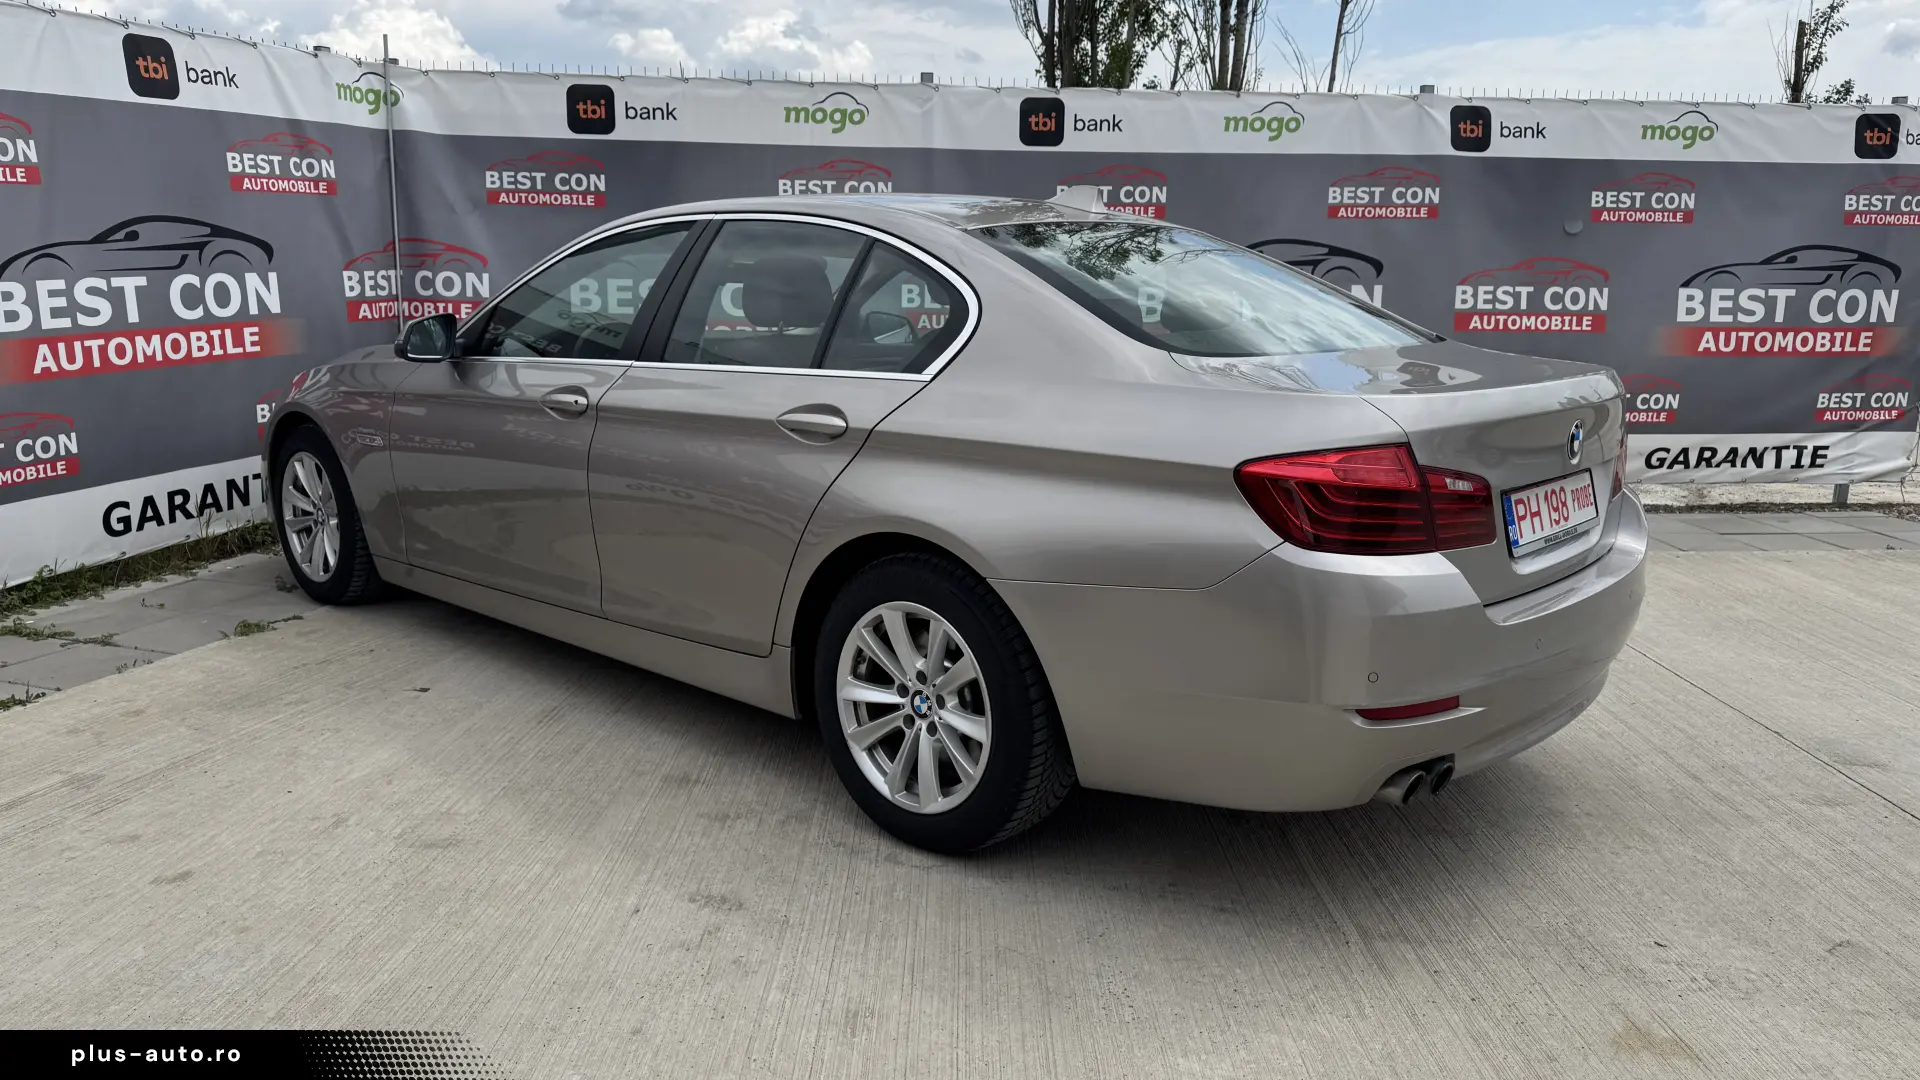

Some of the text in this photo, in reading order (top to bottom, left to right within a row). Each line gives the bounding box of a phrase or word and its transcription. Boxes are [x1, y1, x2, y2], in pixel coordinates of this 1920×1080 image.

[136, 55, 240, 89] tbi bank
[335, 82, 401, 115] mogo
[576, 100, 678, 121] tbi bank
[783, 105, 867, 134] mogo
[1028, 112, 1123, 133] tbi bank
[1223, 115, 1302, 142] mogo
[1458, 120, 1546, 139] tbi bank
[1641, 122, 1716, 150] mogo
[1864, 127, 1891, 145] tbi
[0, 136, 38, 163] ON
[226, 152, 336, 179] BEST CON
[243, 178, 328, 194] AUTOMOBILE
[485, 171, 606, 192] BEST CON
[778, 179, 892, 196] BEST CON
[498, 193, 596, 206] AUTOMOBILE
[1119, 186, 1167, 203] CON
[1328, 187, 1440, 204] BEST CON
[1590, 191, 1696, 210] BEST CON
[1844, 194, 1920, 212] BEST CO
[1338, 207, 1428, 218] AUTOMOBILE
[1600, 211, 1684, 223] AUTOMOBILE
[1853, 213, 1920, 225] AUTOMOBIL
[342, 269, 490, 298] BEST CON
[0, 271, 281, 333] BEST CON
[1454, 285, 1609, 311] BEST CON
[1676, 288, 1899, 324] BEST CON
[1468, 315, 1592, 331] AUTOMOBILE
[33, 326, 261, 374] AUTOMOBILE
[1697, 331, 1873, 353] AUTOMOBILE
[1636, 393, 1680, 410] CON
[1816, 392, 1909, 408] BEST CON
[1823, 410, 1898, 421] AUTOMOBILE
[15, 432, 78, 462] CON
[1644, 444, 1830, 470] GARANTIE
[1508, 525, 1518, 541] RO
[1514, 493, 1544, 539] PH
[1544, 486, 1570, 528] 198
[1570, 483, 1593, 513] PROBE
